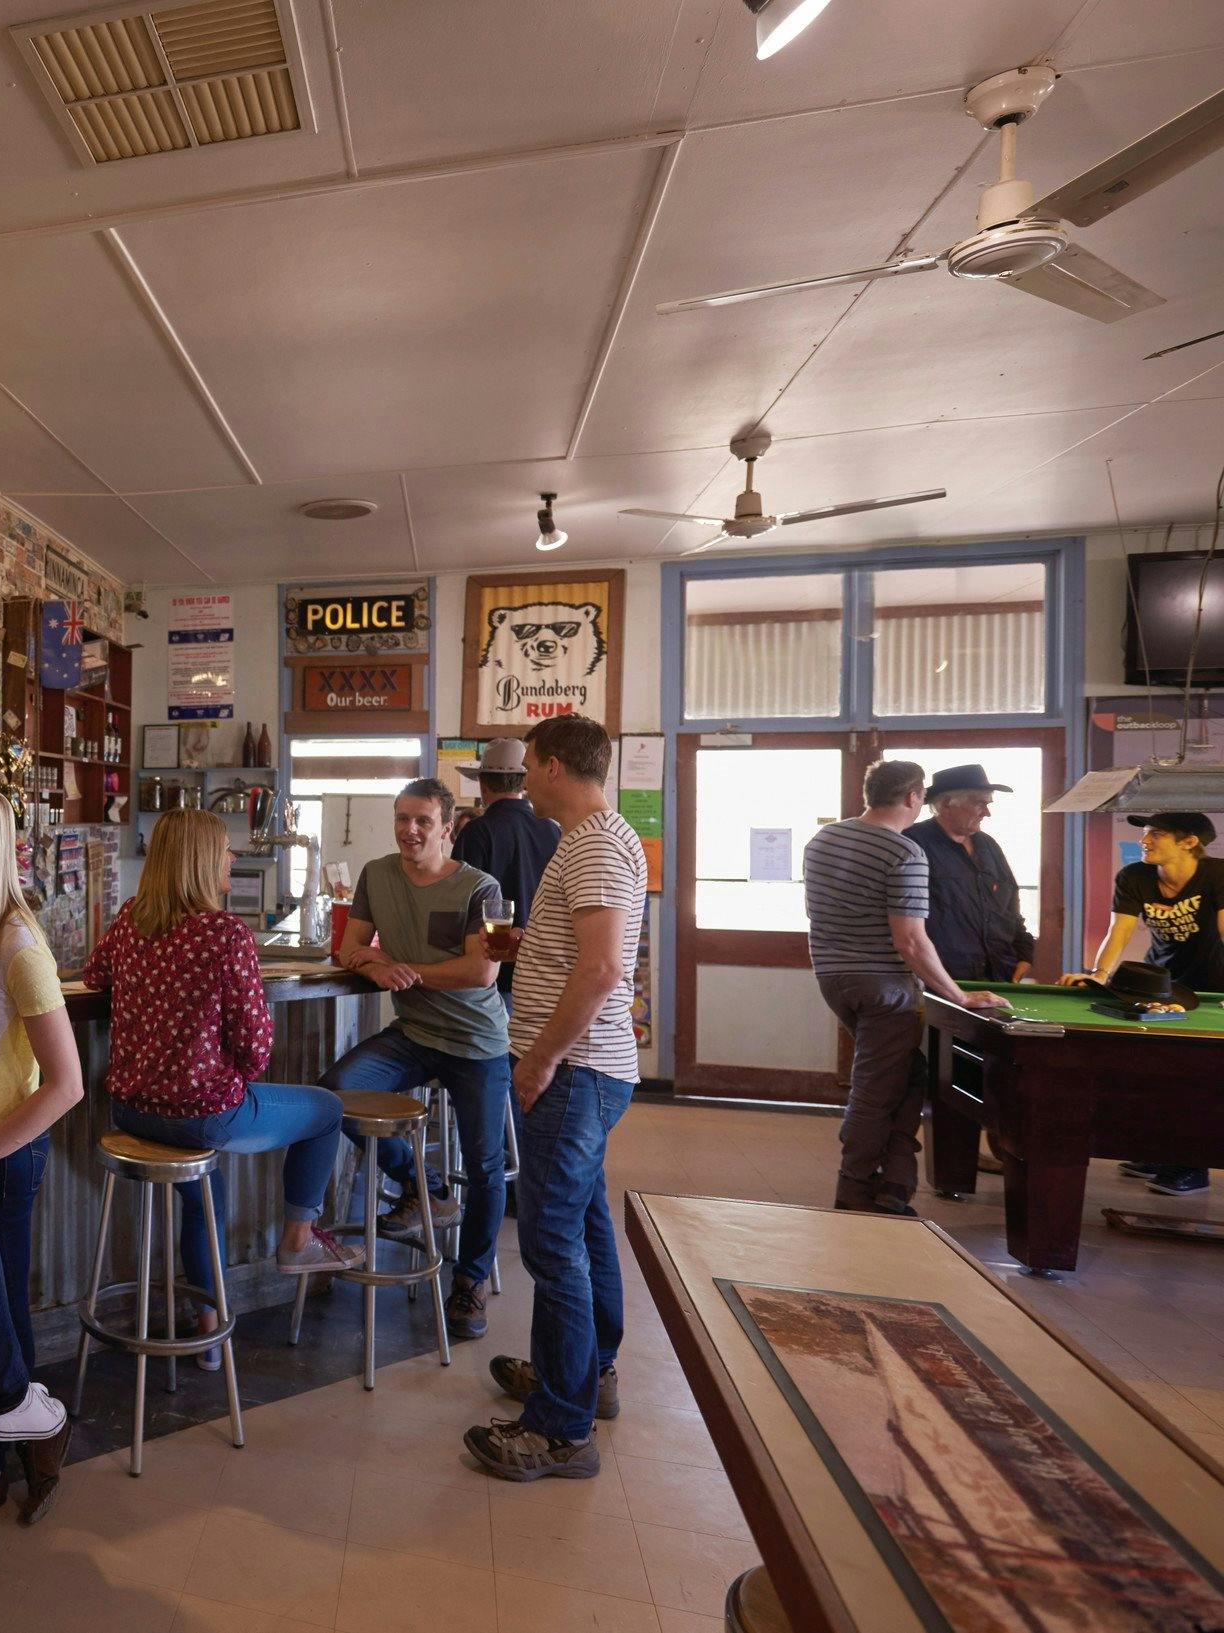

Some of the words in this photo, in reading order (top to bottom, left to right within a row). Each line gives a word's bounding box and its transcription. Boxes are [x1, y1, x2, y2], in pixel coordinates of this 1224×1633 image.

[306, 601, 406, 630] POLICE
[318, 670, 398, 692] XXXX
[326, 692, 353, 707] Our
[495, 675, 587, 711] Bundaberg
[526, 702, 573, 717] RUM
